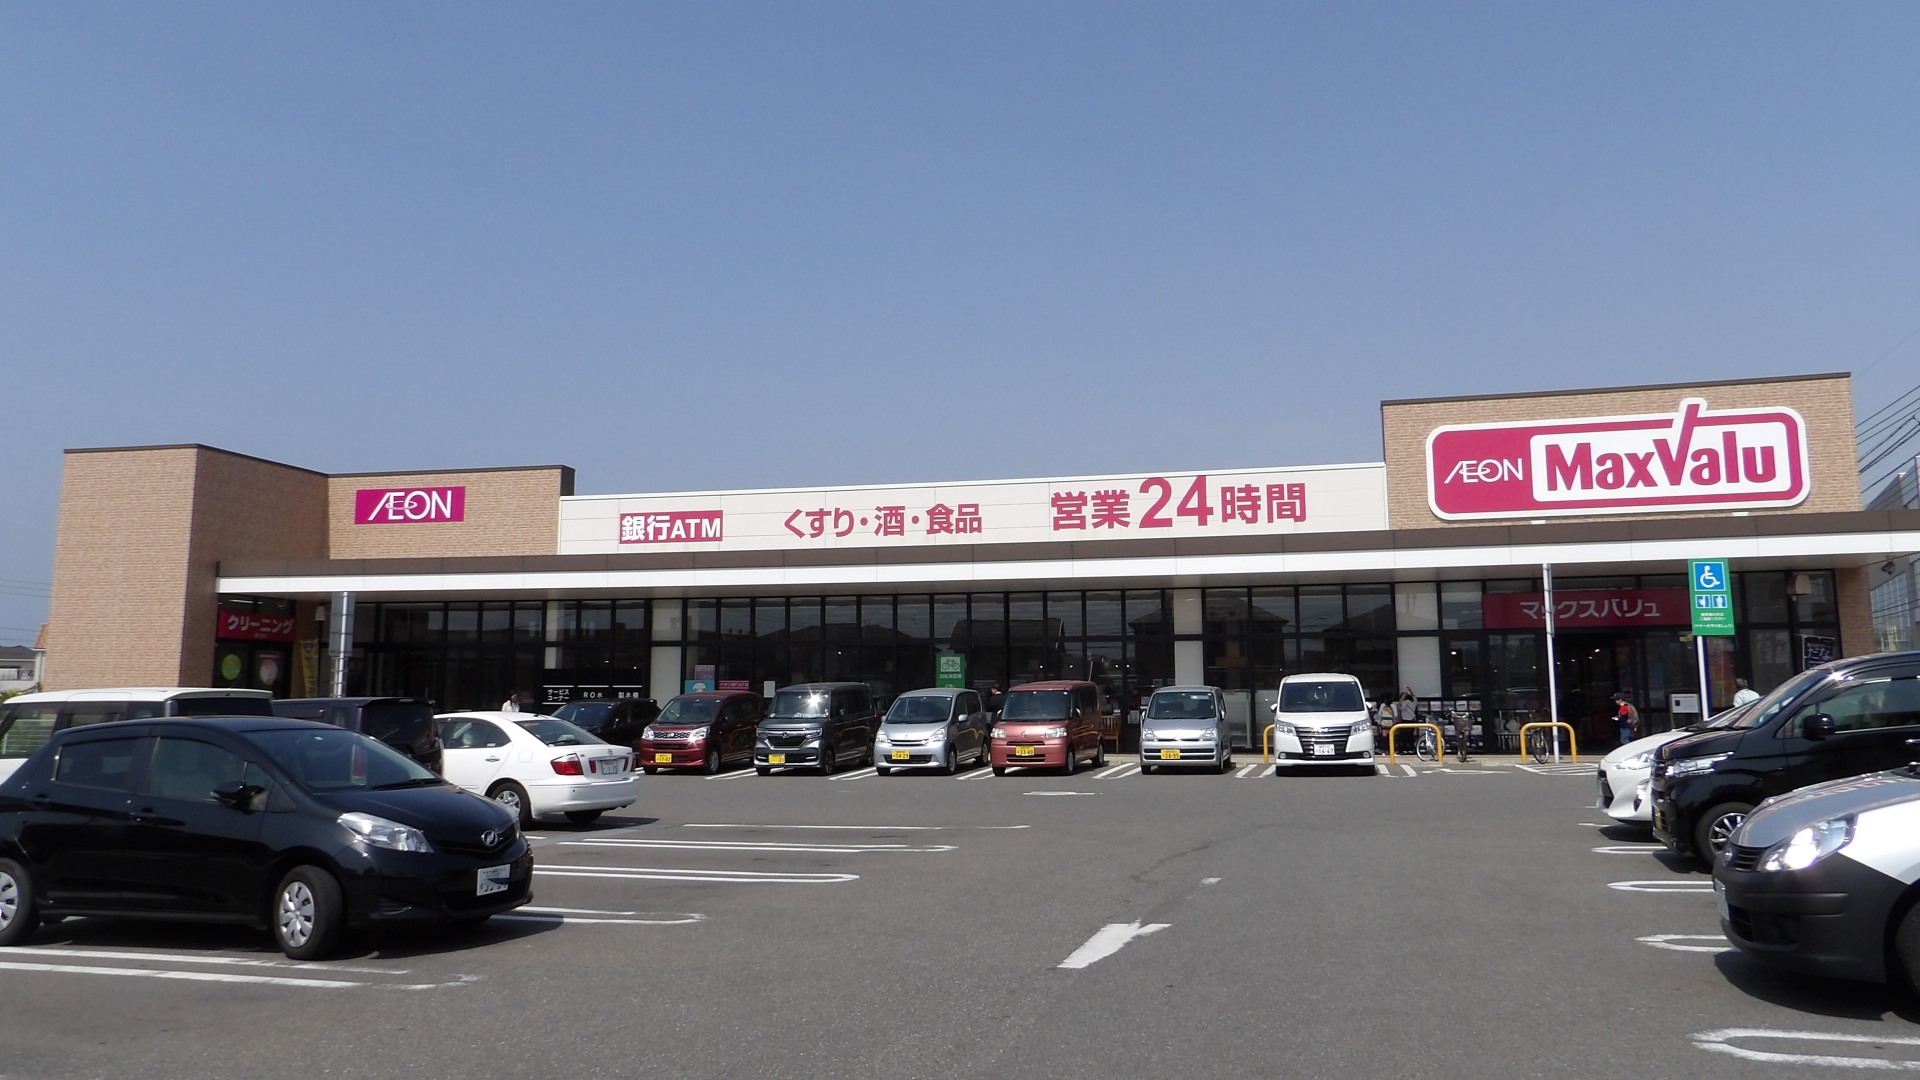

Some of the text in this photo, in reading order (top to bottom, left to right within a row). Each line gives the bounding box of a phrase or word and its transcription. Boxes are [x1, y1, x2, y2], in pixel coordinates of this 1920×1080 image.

[1545, 404, 1775, 491] MaxValu
[784, 503, 983, 538] くすり・酒・食品
[1051, 475, 1307, 531] 営業24時間
[621, 514, 721, 541] 銀行ATM
[227, 615, 294, 634] クリーニング
